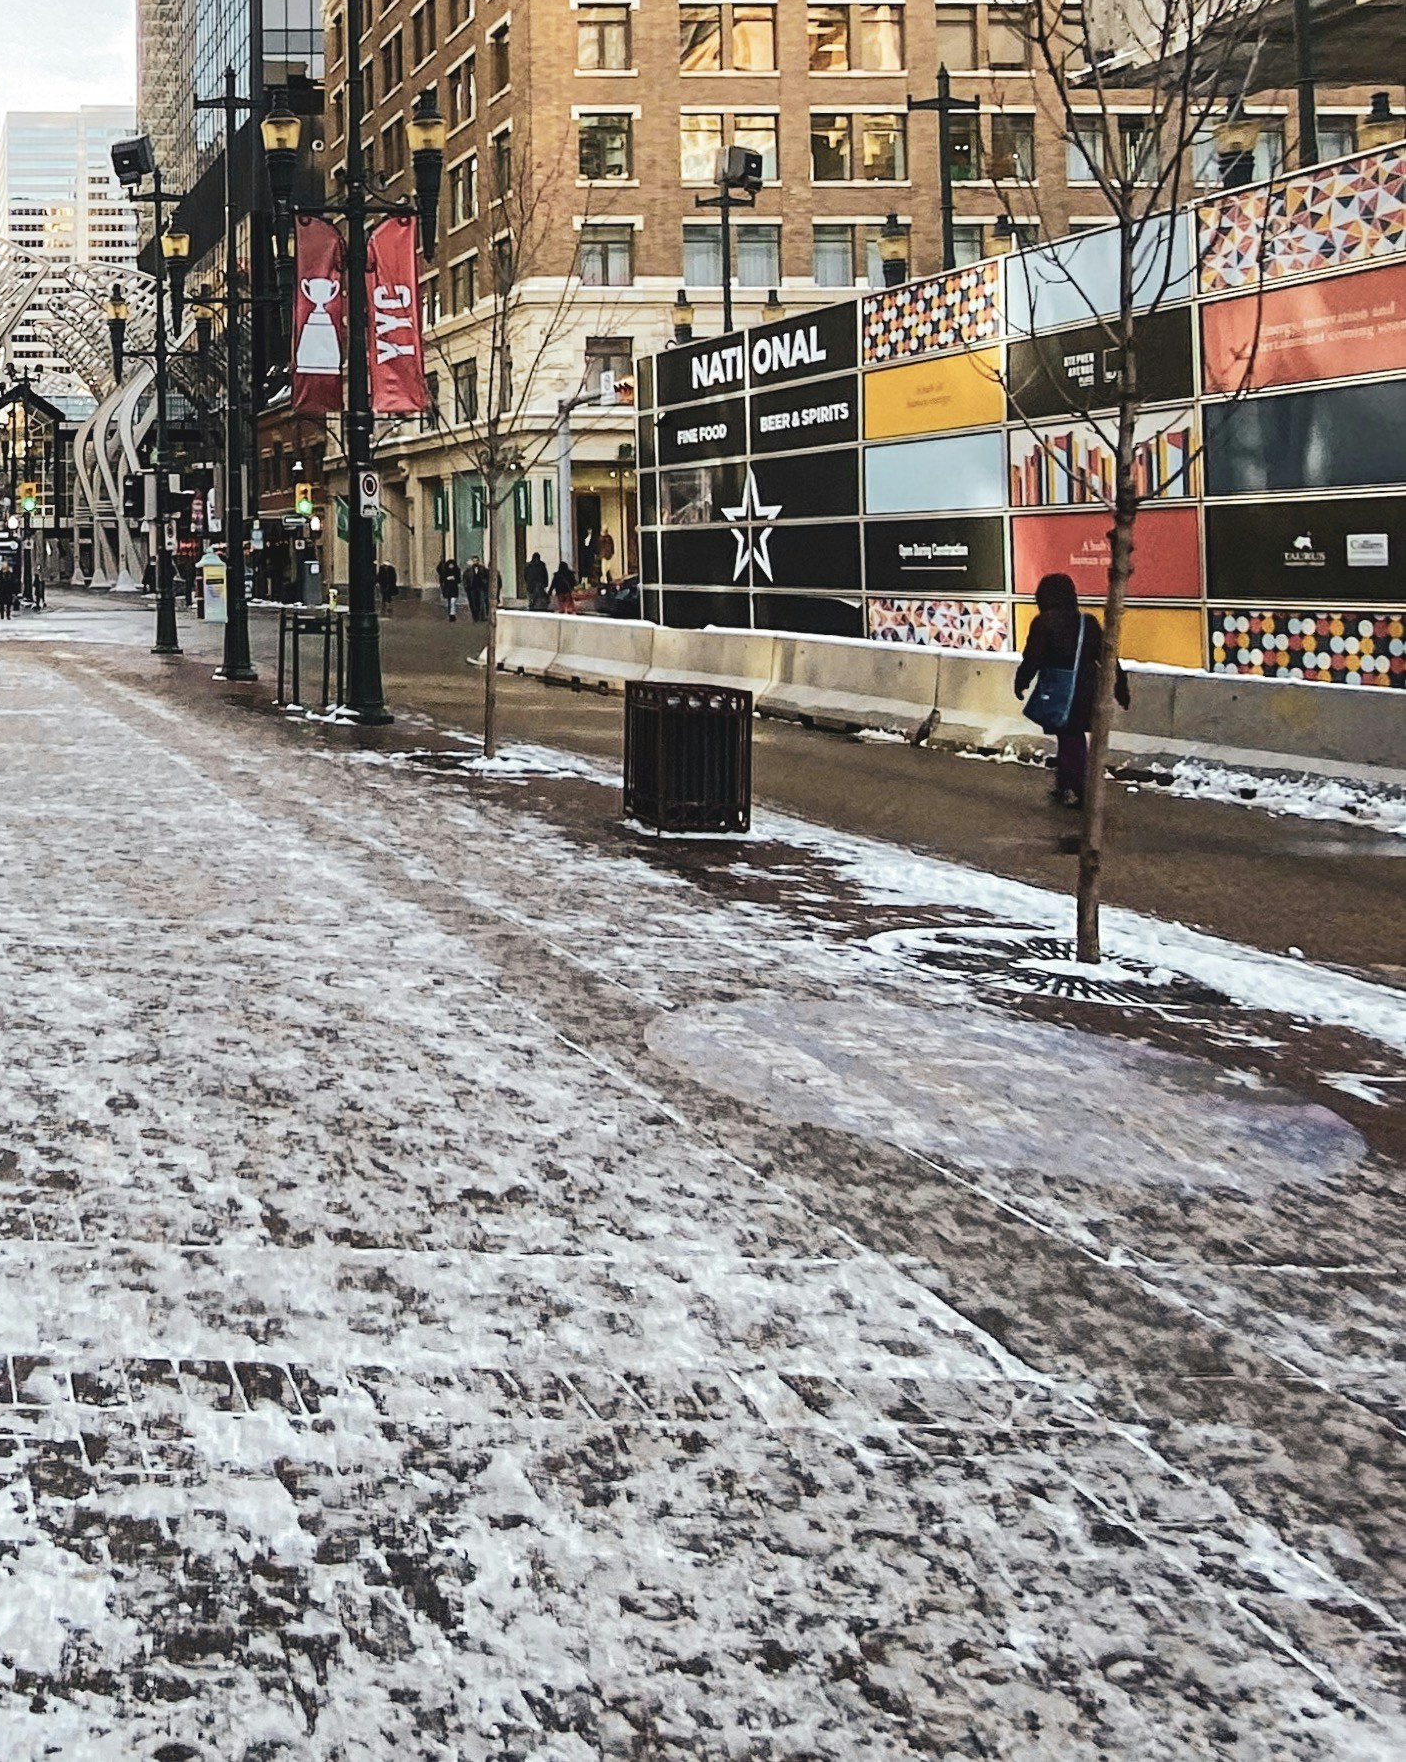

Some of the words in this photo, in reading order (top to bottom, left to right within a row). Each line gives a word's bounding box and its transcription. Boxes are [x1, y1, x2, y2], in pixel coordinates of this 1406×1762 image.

[373, 284, 416, 365] YYC
[691, 325, 827, 390] NATIONAL
[676, 426, 699, 446] FINE
[700, 423, 727, 443] FOOD
[759, 414, 790, 434] BEER
[791, 412, 800, 428] &
[801, 402, 850, 427] SPIRITS
